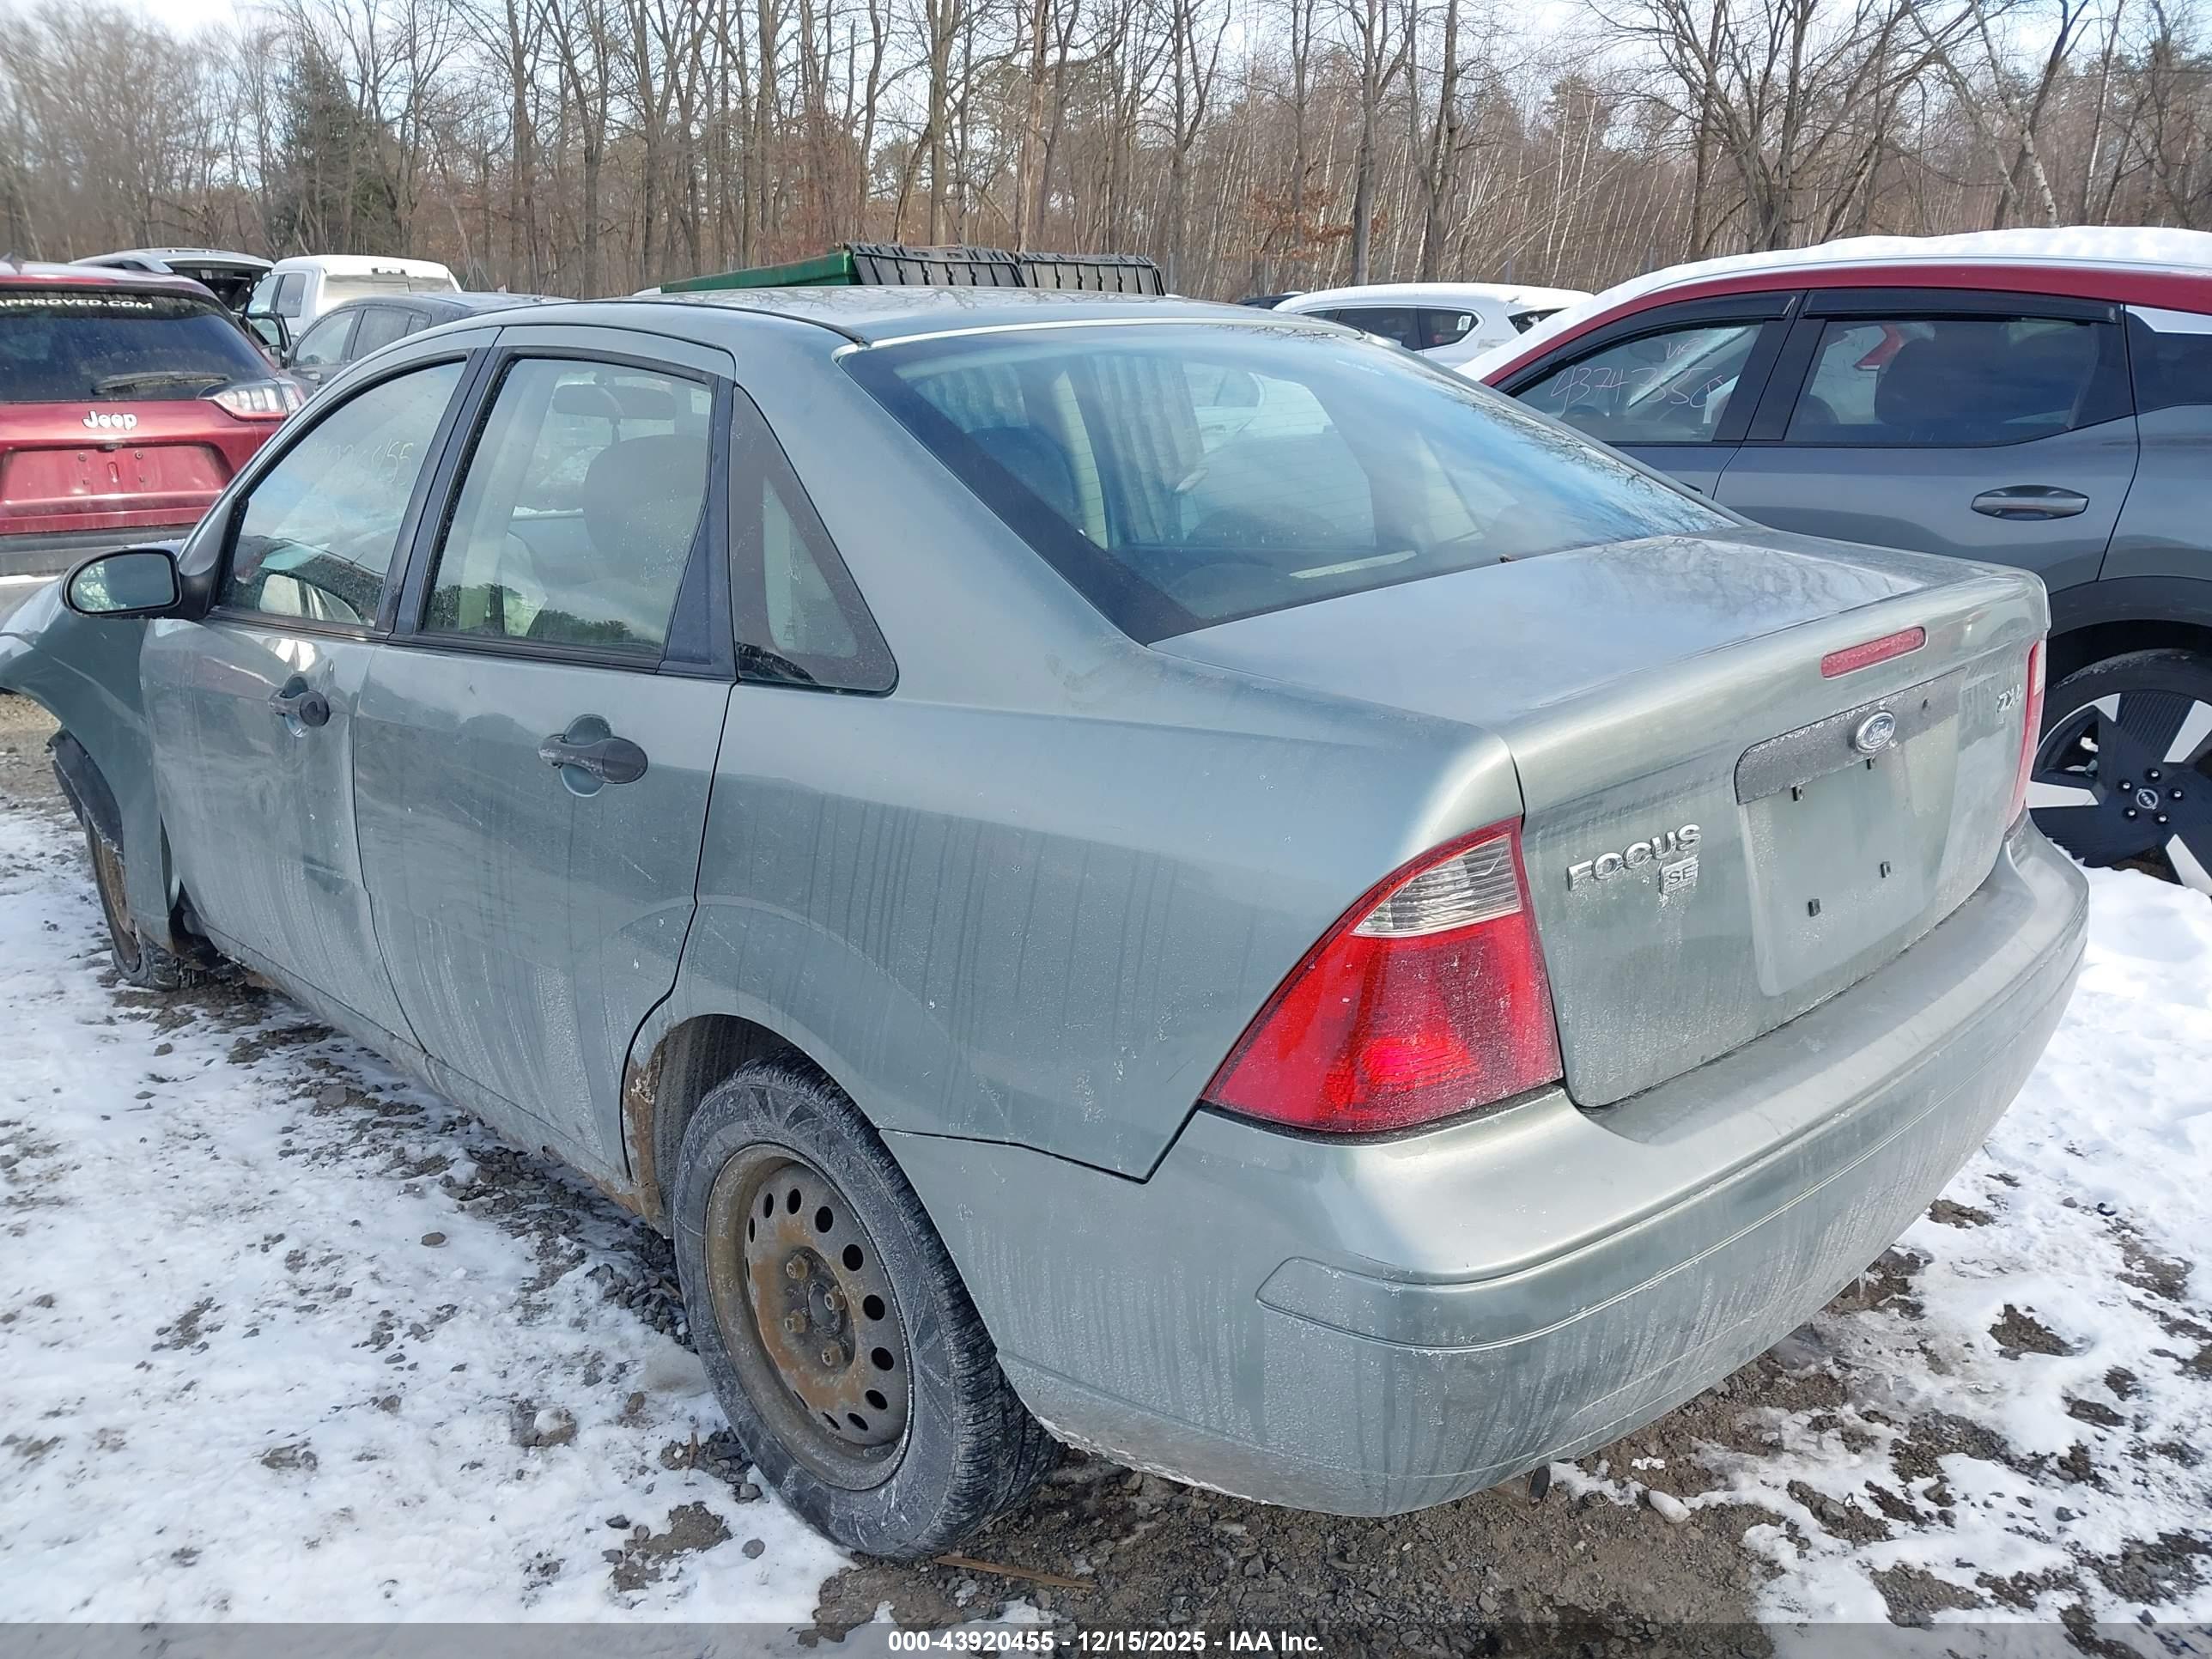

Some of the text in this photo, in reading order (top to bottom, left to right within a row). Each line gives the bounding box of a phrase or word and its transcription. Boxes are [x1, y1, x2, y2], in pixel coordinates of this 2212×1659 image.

[82, 410, 138, 431] Jeep
[1566, 823, 1702, 891] FOCUS
[1668, 865, 1695, 886] SE
